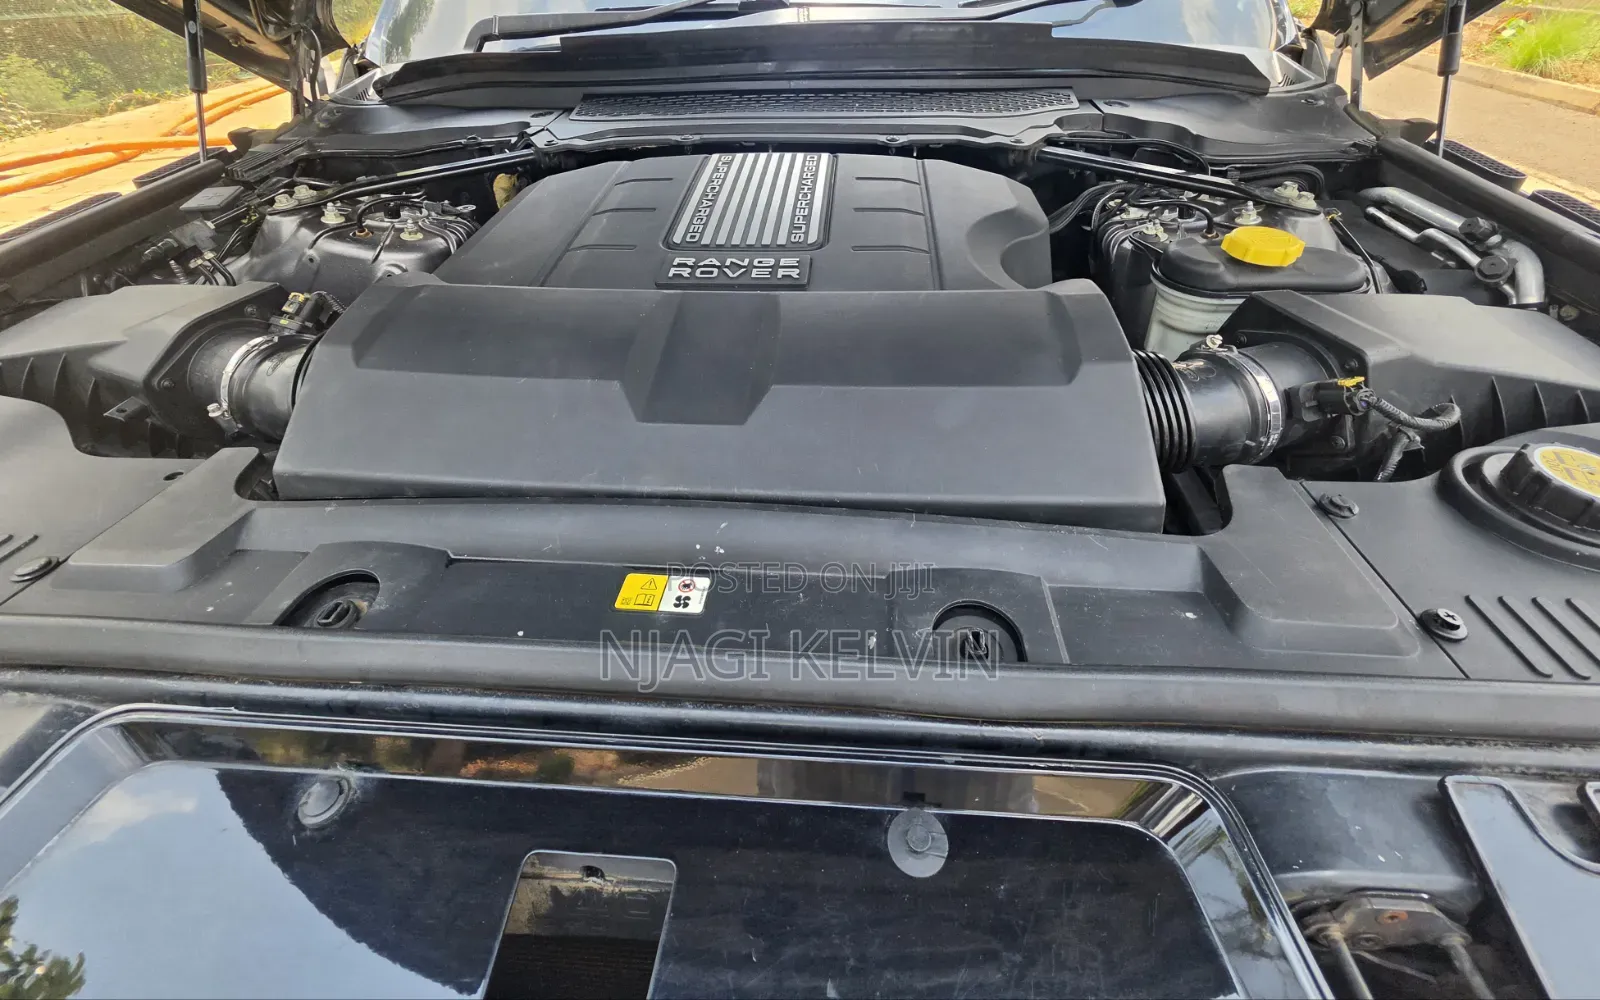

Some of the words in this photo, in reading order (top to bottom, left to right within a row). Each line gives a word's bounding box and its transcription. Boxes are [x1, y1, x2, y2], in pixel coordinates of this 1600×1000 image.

[685, 155, 732, 242] SUPERCHARGED
[790, 154, 818, 243] SUPERCHARGED
[668, 267, 800, 279] ROVER
[673, 257, 800, 266] RANGE
